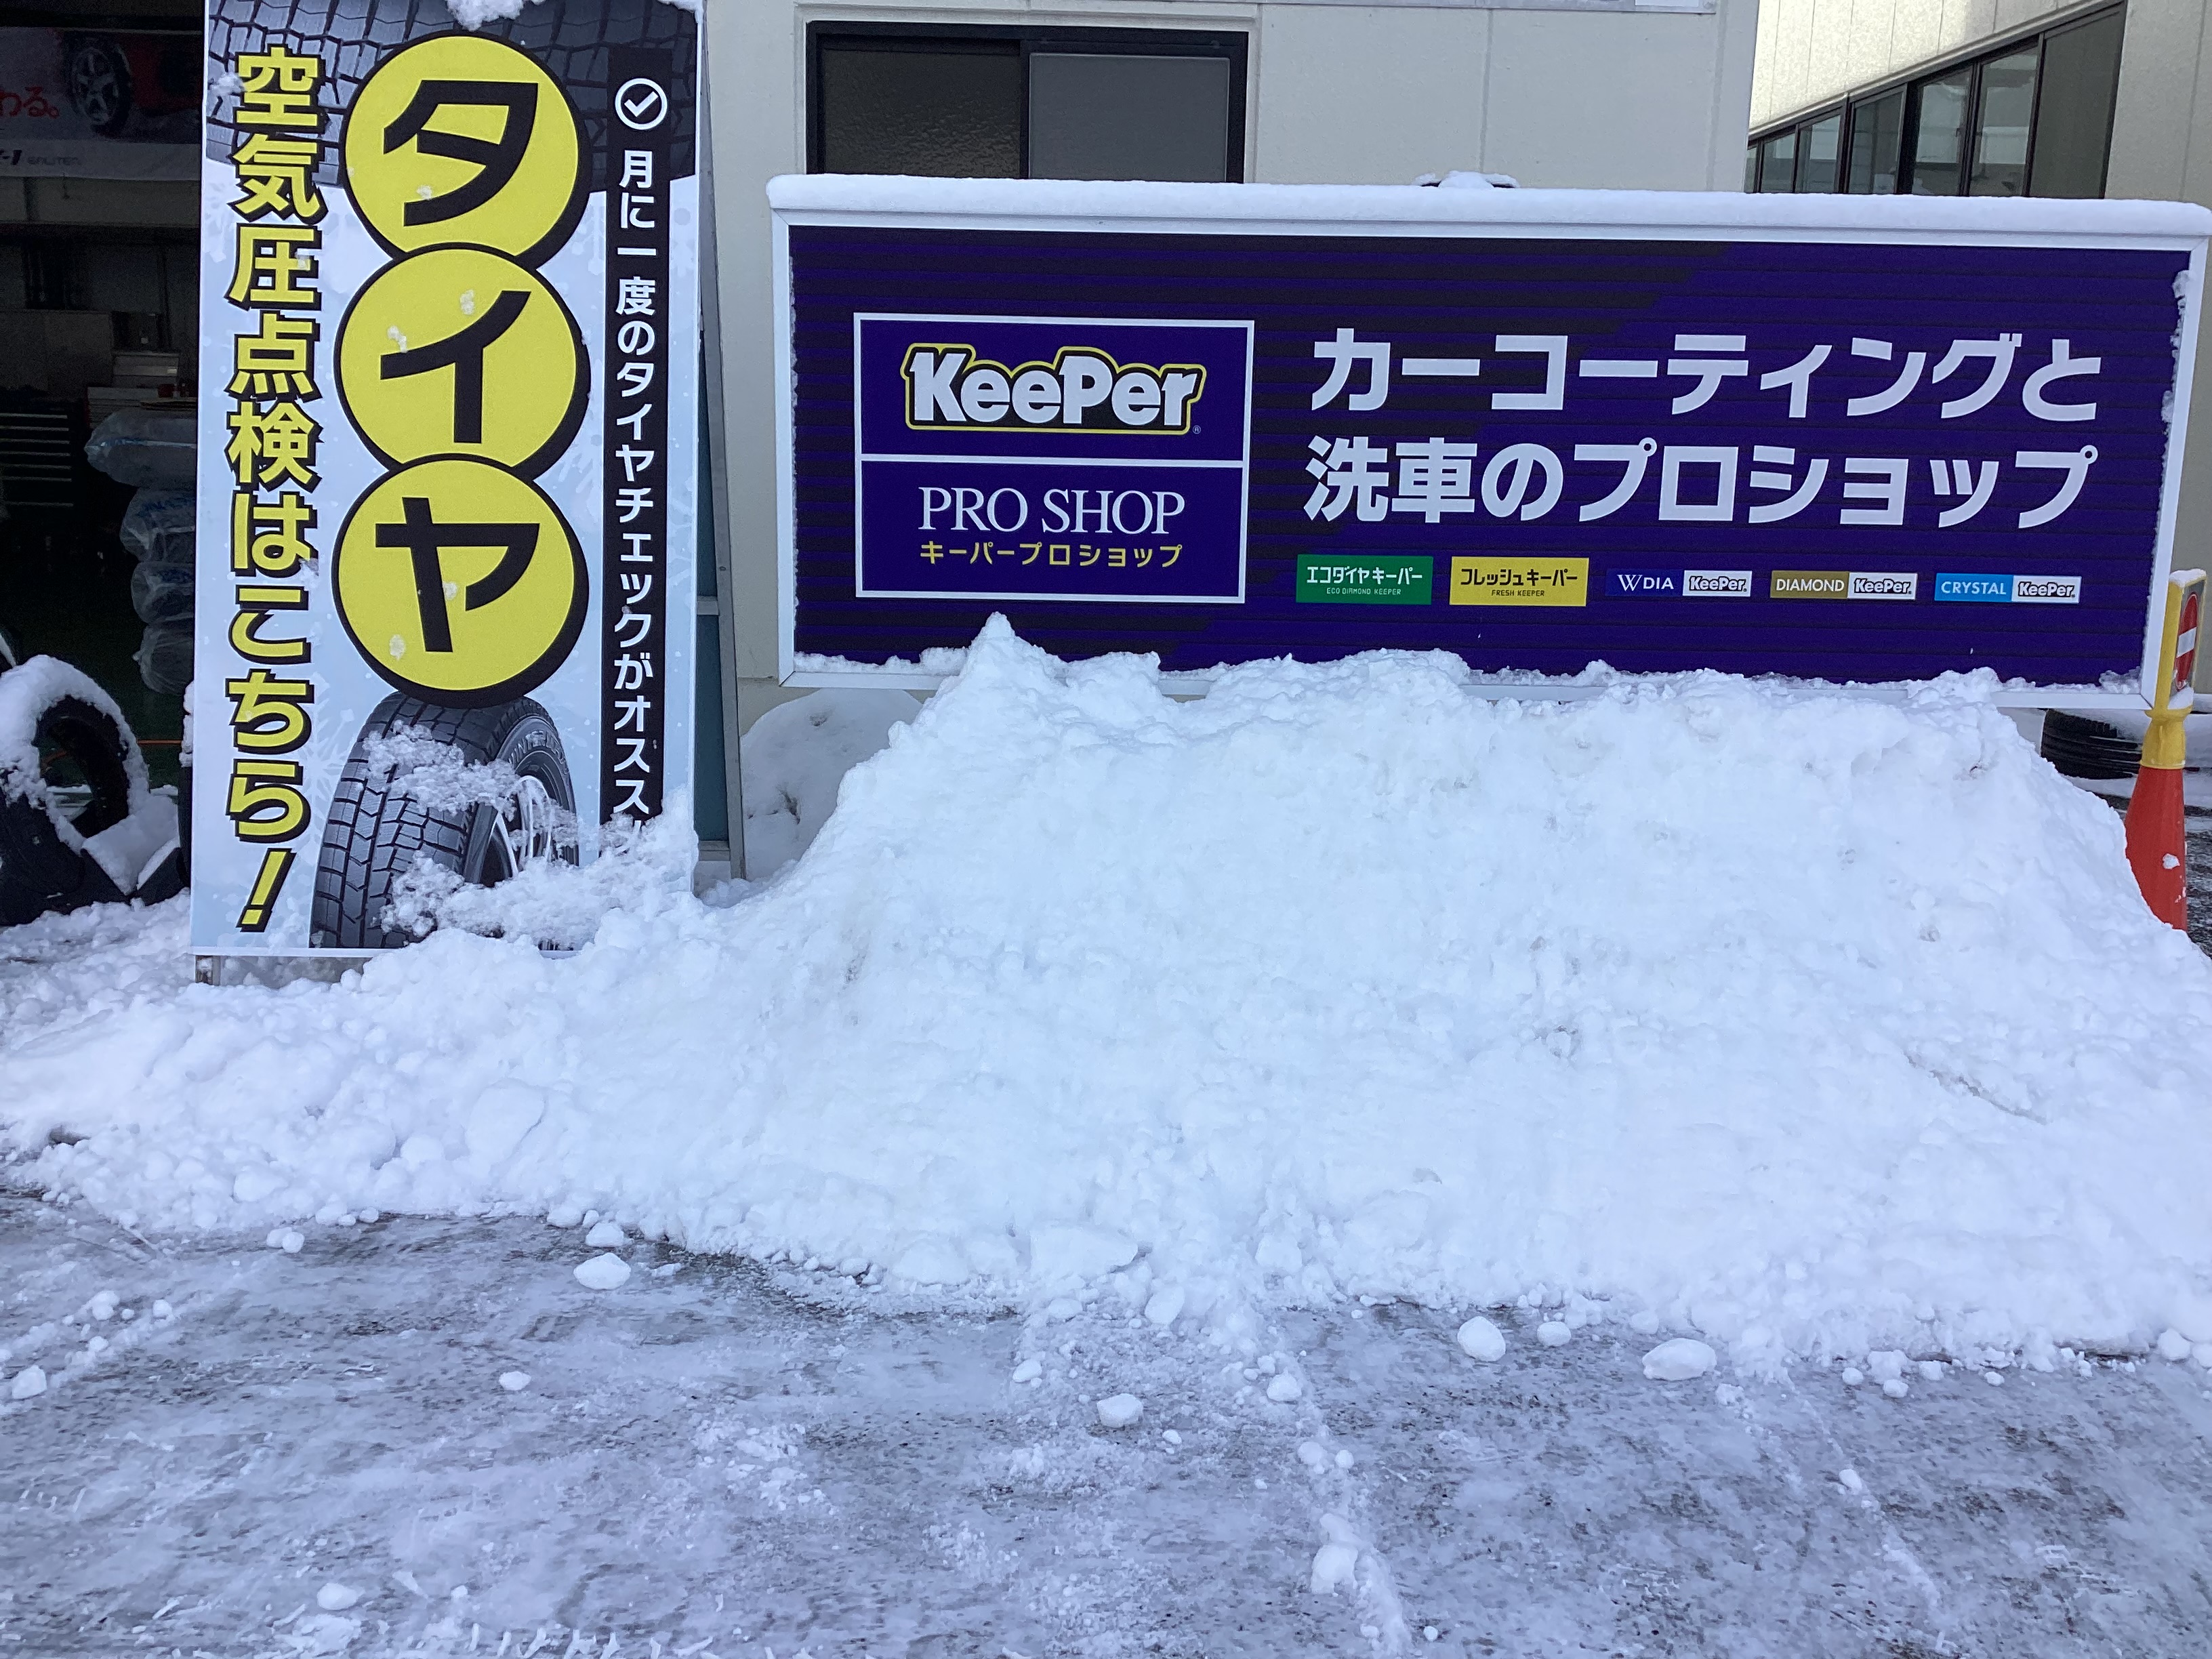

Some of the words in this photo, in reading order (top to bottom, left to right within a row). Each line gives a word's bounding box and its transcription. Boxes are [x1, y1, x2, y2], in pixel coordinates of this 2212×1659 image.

[375, 79, 541, 653] タイヤ
[907, 350, 1200, 428] KeePer
[1311, 327, 2102, 422] カーコーティングと
[228, 47, 323, 928] 空気圧点検はこちら！
[613, 150, 657, 832] 月に一度のタイヤチェックがオスス
[1303, 435, 2099, 529] 洗車のプロショップ
[918, 487, 1028, 532] PRO
[1042, 489, 1185, 535] SHOP
[920, 541, 1183, 567] キーパープロショップ
[1307, 565, 1422, 585] エコダイヤキーパー
[1460, 568, 1578, 586] フレッシュキーパー
[1689, 576, 1746, 592] KeePer
[1776, 578, 1845, 592] DIAMOND
[1854, 578, 1911, 594] KeePer
[1941, 581, 2007, 595] CRYSTAL
[2018, 581, 2074, 597] KeePer
